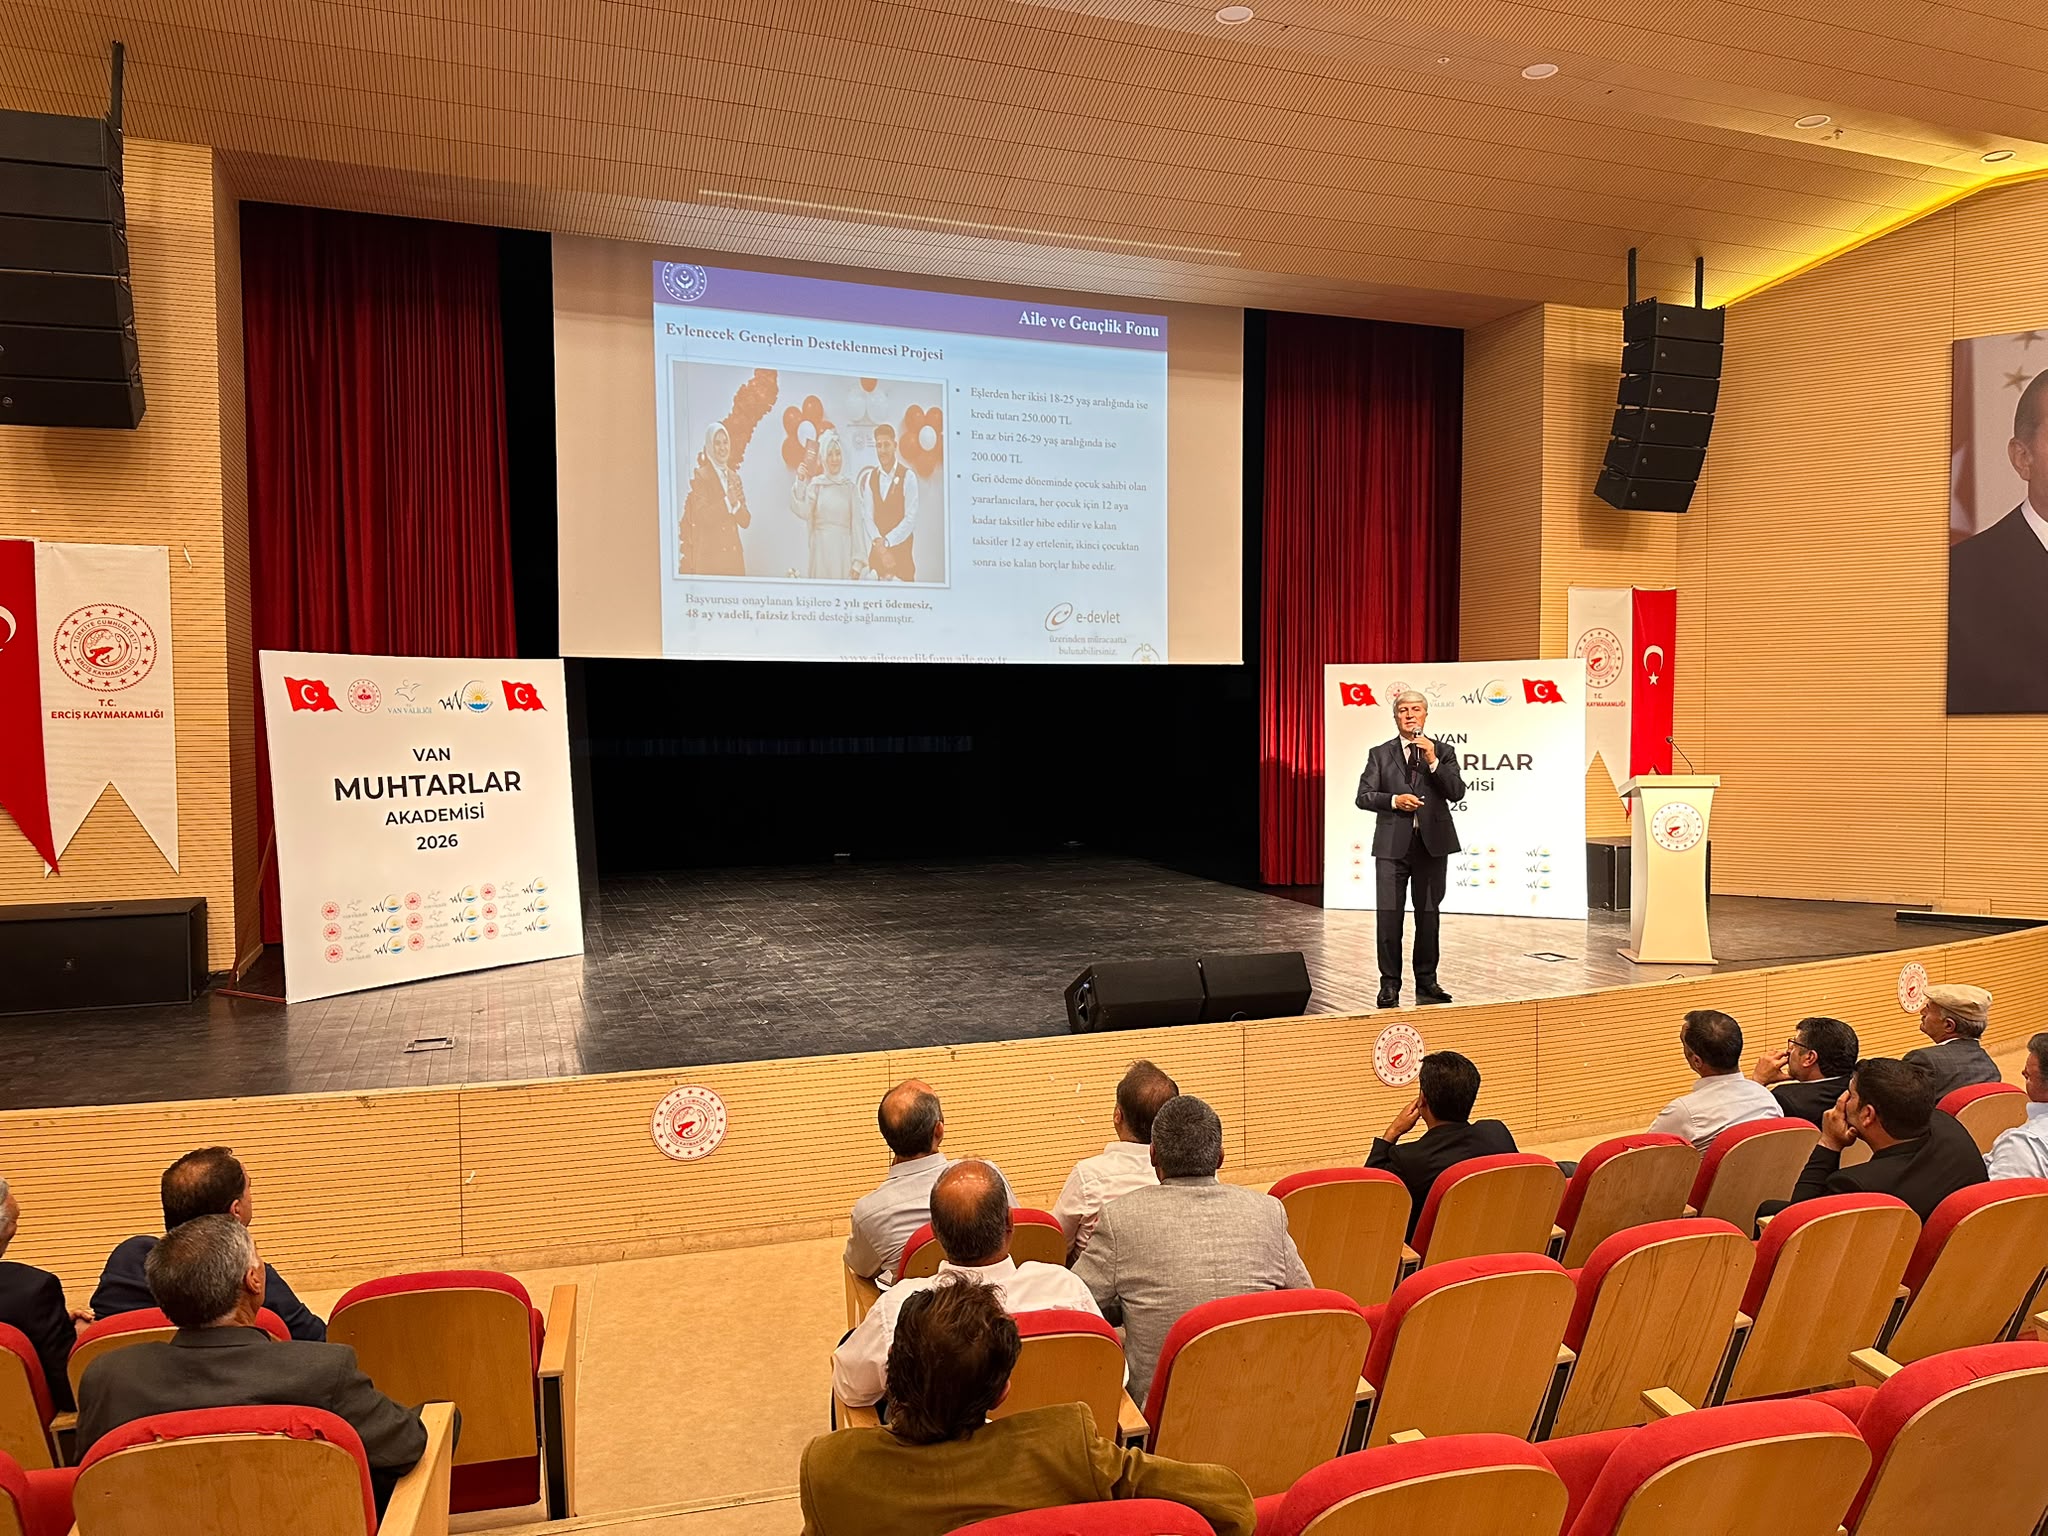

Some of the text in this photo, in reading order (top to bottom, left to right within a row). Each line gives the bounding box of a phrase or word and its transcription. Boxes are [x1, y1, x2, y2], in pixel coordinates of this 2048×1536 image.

[1018, 310, 1159, 337] Aile ve Gençlik Fonu
[666, 322, 943, 362] Evlenecek Gençlerin Desteklenmesi Projesi
[971, 388, 1148, 410] Eşlerden her ikisi 18-25 yaş aralığında ise
[971, 409, 1072, 425] kredi tutarı 250.000 TL
[972, 430, 983, 440] En
[999, 432, 1014, 442] biri
[1016, 433, 1041, 443] 26-29
[1044, 437, 1058, 446] yaş
[1060, 436, 1102, 449] aralığında
[1104, 439, 1116, 448] ise
[972, 452, 1022, 464] 200.000 TL
[972, 473, 1146, 492] Geri ödeme döneminde çocuk sahibi olan
[972, 496, 1128, 511] yararlanıcılara, her çocuk için 12 aya
[972, 516, 996, 526] kadar
[999, 517, 1034, 527] taksitler
[1036, 518, 1055, 528] hibe
[1057, 519, 1079, 529] edilir
[1094, 521, 1117, 530] kalan
[972, 537, 1139, 552] taksitler 12 ay ertelenir, ikinci çocuktan
[972, 559, 996, 568] sonra
[999, 558, 1011, 568] ise
[1014, 559, 1036, 568] kalan
[1039, 560, 1069, 571] borçlar
[1072, 561, 1089, 570] hibe
[686, 594, 932, 611] Başvurusu onaylanan kişilere 2 yılı geri ödemesiz,
[686, 610, 699, 619] 48
[702, 611, 714, 621] ay
[718, 610, 753, 622] vadeli,
[756, 611, 788, 621] faizsiz
[791, 611, 816, 622] kredi
[819, 612, 852, 624] desteği
[1076, 611, 1120, 623] e-devlet
[74, 620, 138, 644] TÜRKİYE CUMHURİYETİ
[1049, 635, 1085, 643] üzerinden
[51, 708, 164, 720] ERCİŞ KAYMAKAMLIĞI
[1434, 733, 1467, 744] VAN
[412, 747, 451, 762] VAN
[334, 770, 521, 802] MUHTARLAR
[385, 802, 484, 826] AKADEMİSİ
[416, 834, 458, 850] 2026
